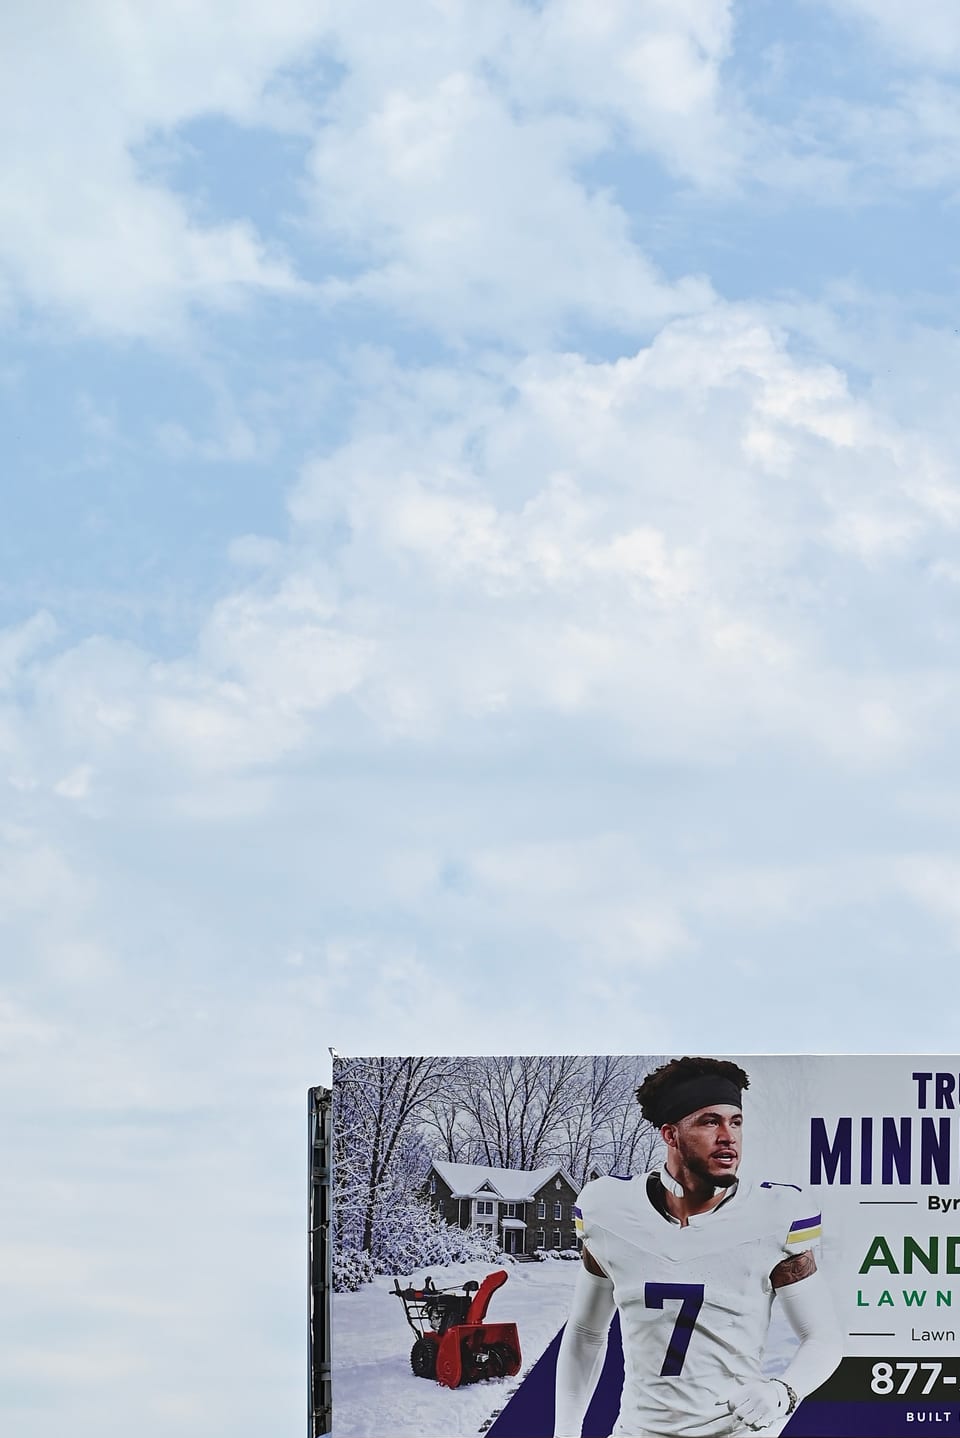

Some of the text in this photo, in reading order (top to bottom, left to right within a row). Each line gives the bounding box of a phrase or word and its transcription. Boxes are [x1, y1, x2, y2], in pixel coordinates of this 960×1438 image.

[857, 1289, 953, 1307] LAWN
[644, 1282, 706, 1377] 7
[911, 1328, 957, 1342] Lawn
[906, 1411, 952, 1423] BUILT
